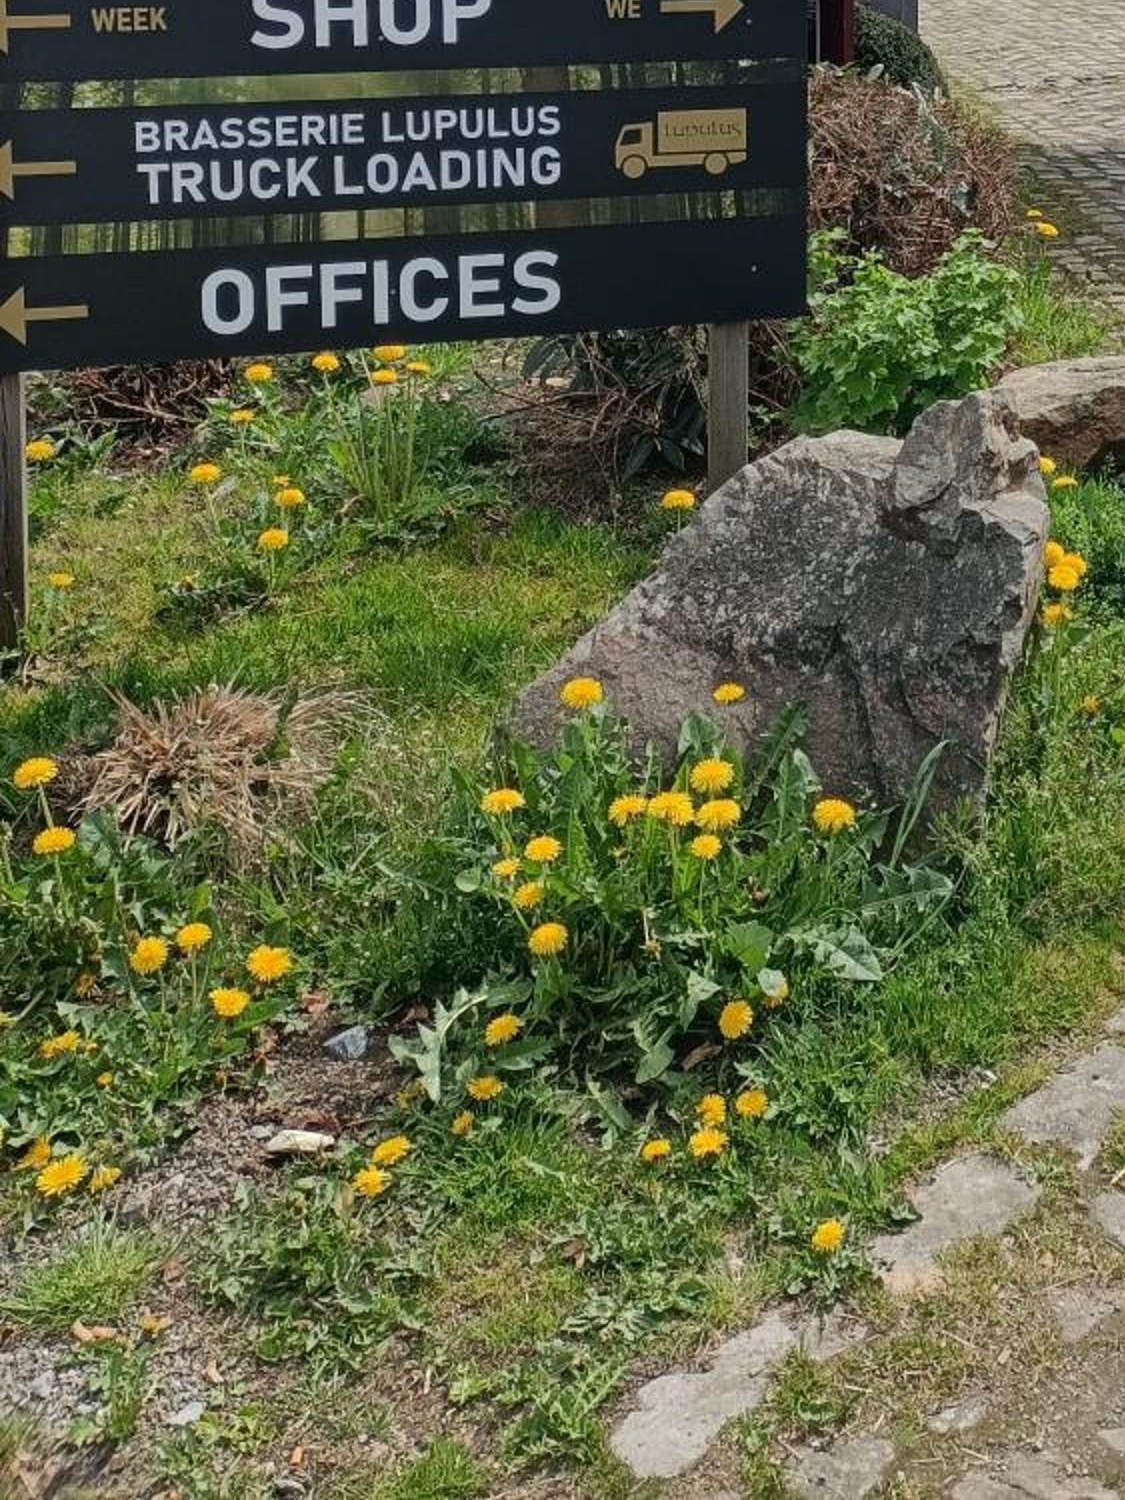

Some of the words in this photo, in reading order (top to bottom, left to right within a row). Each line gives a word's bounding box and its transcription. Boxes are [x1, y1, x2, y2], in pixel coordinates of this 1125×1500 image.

[91, 5, 168, 33] WEEK
[133, 112, 366, 153] BRASSERIE
[381, 105, 562, 144] LUPULUS
[136, 158, 321, 205] TRUCK
[333, 145, 562, 196] LOADING
[200, 249, 562, 336] OFFICES
